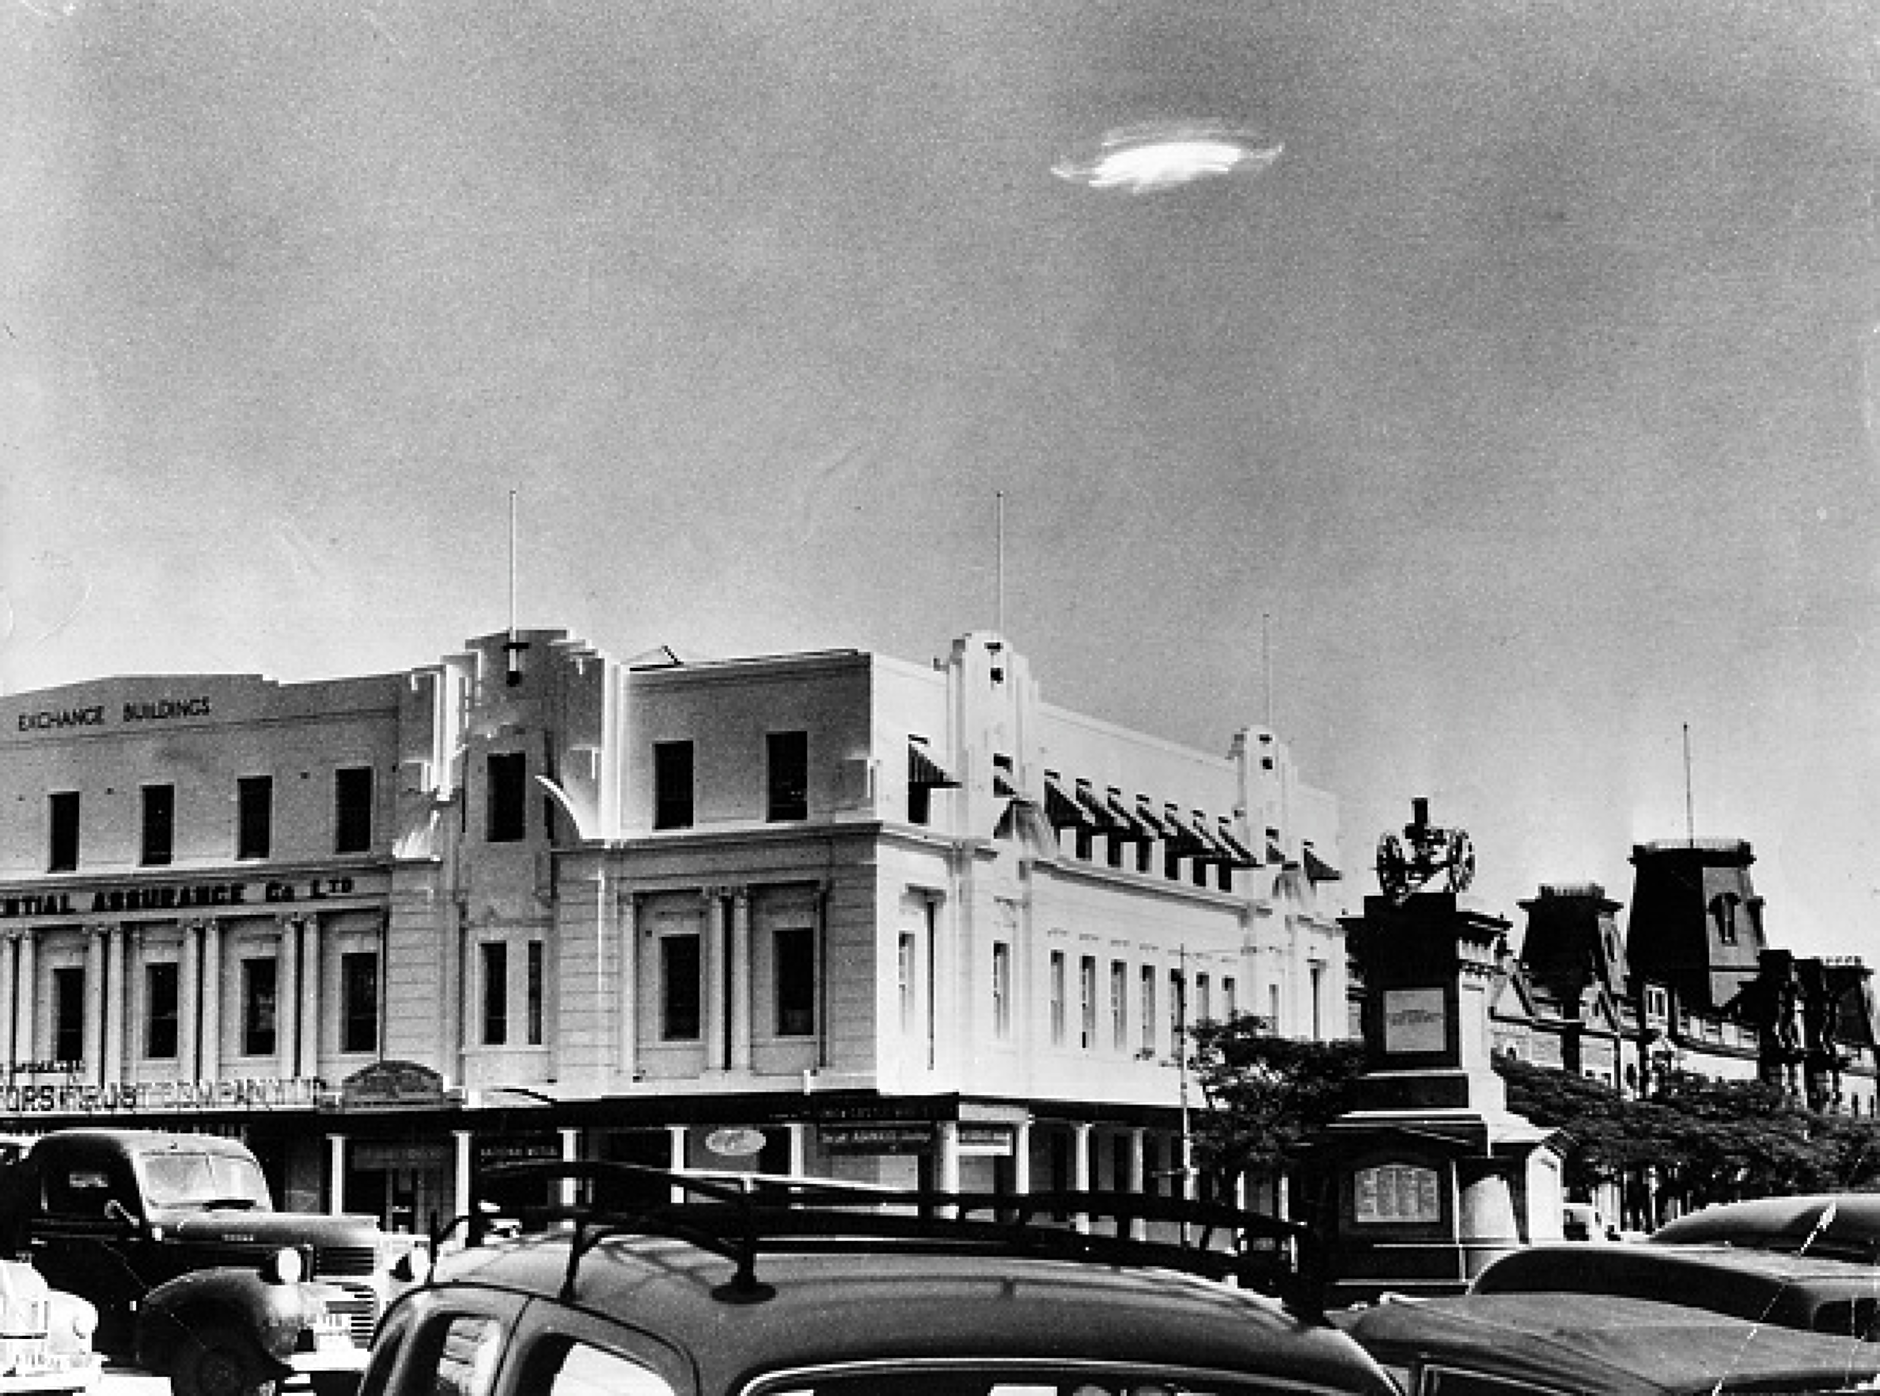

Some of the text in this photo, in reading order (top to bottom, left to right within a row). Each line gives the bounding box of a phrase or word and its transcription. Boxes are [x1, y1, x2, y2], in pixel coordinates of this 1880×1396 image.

[18, 696, 210, 731] EXCHANGE BUILDINGS
[92, 883, 247, 911] ASSURANCE
[0, 1084, 55, 1112] ORS
